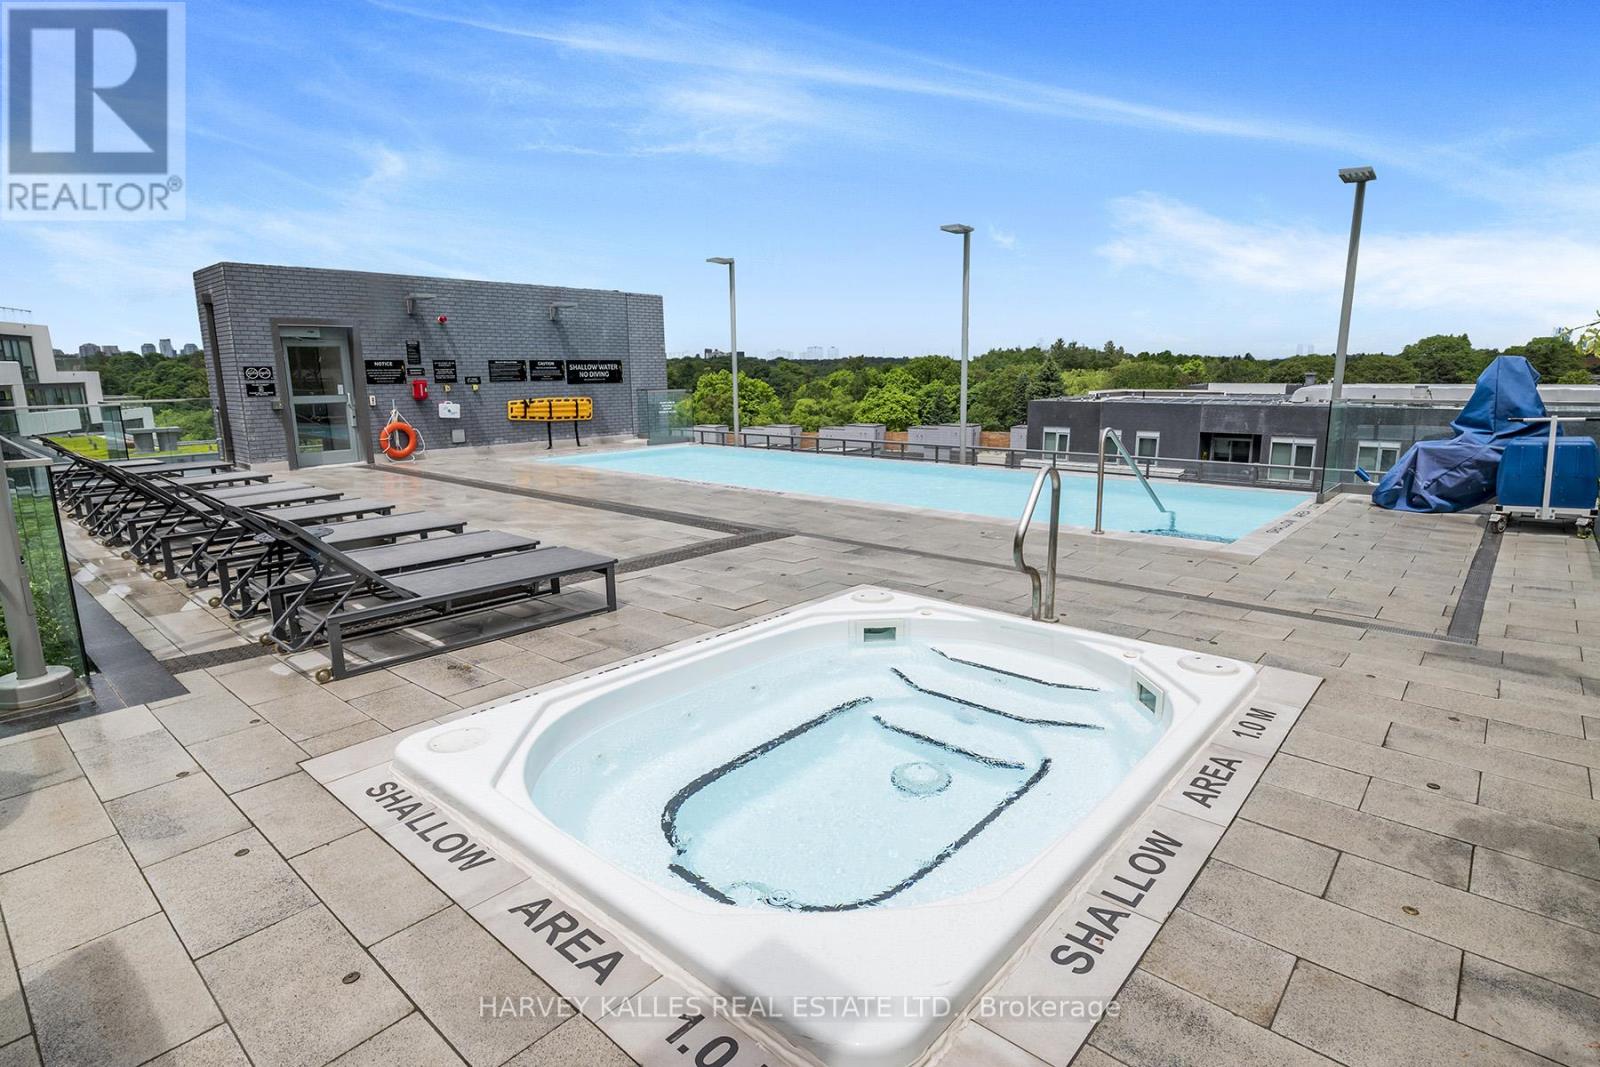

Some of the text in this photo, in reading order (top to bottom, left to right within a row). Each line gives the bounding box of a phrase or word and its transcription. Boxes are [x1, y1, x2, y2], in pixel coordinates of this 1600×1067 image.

[365, 781, 740, 1067] SHALLOW AREA 1.0
[1050, 707, 1277, 975] SHALLOW AREA 1.0 M
